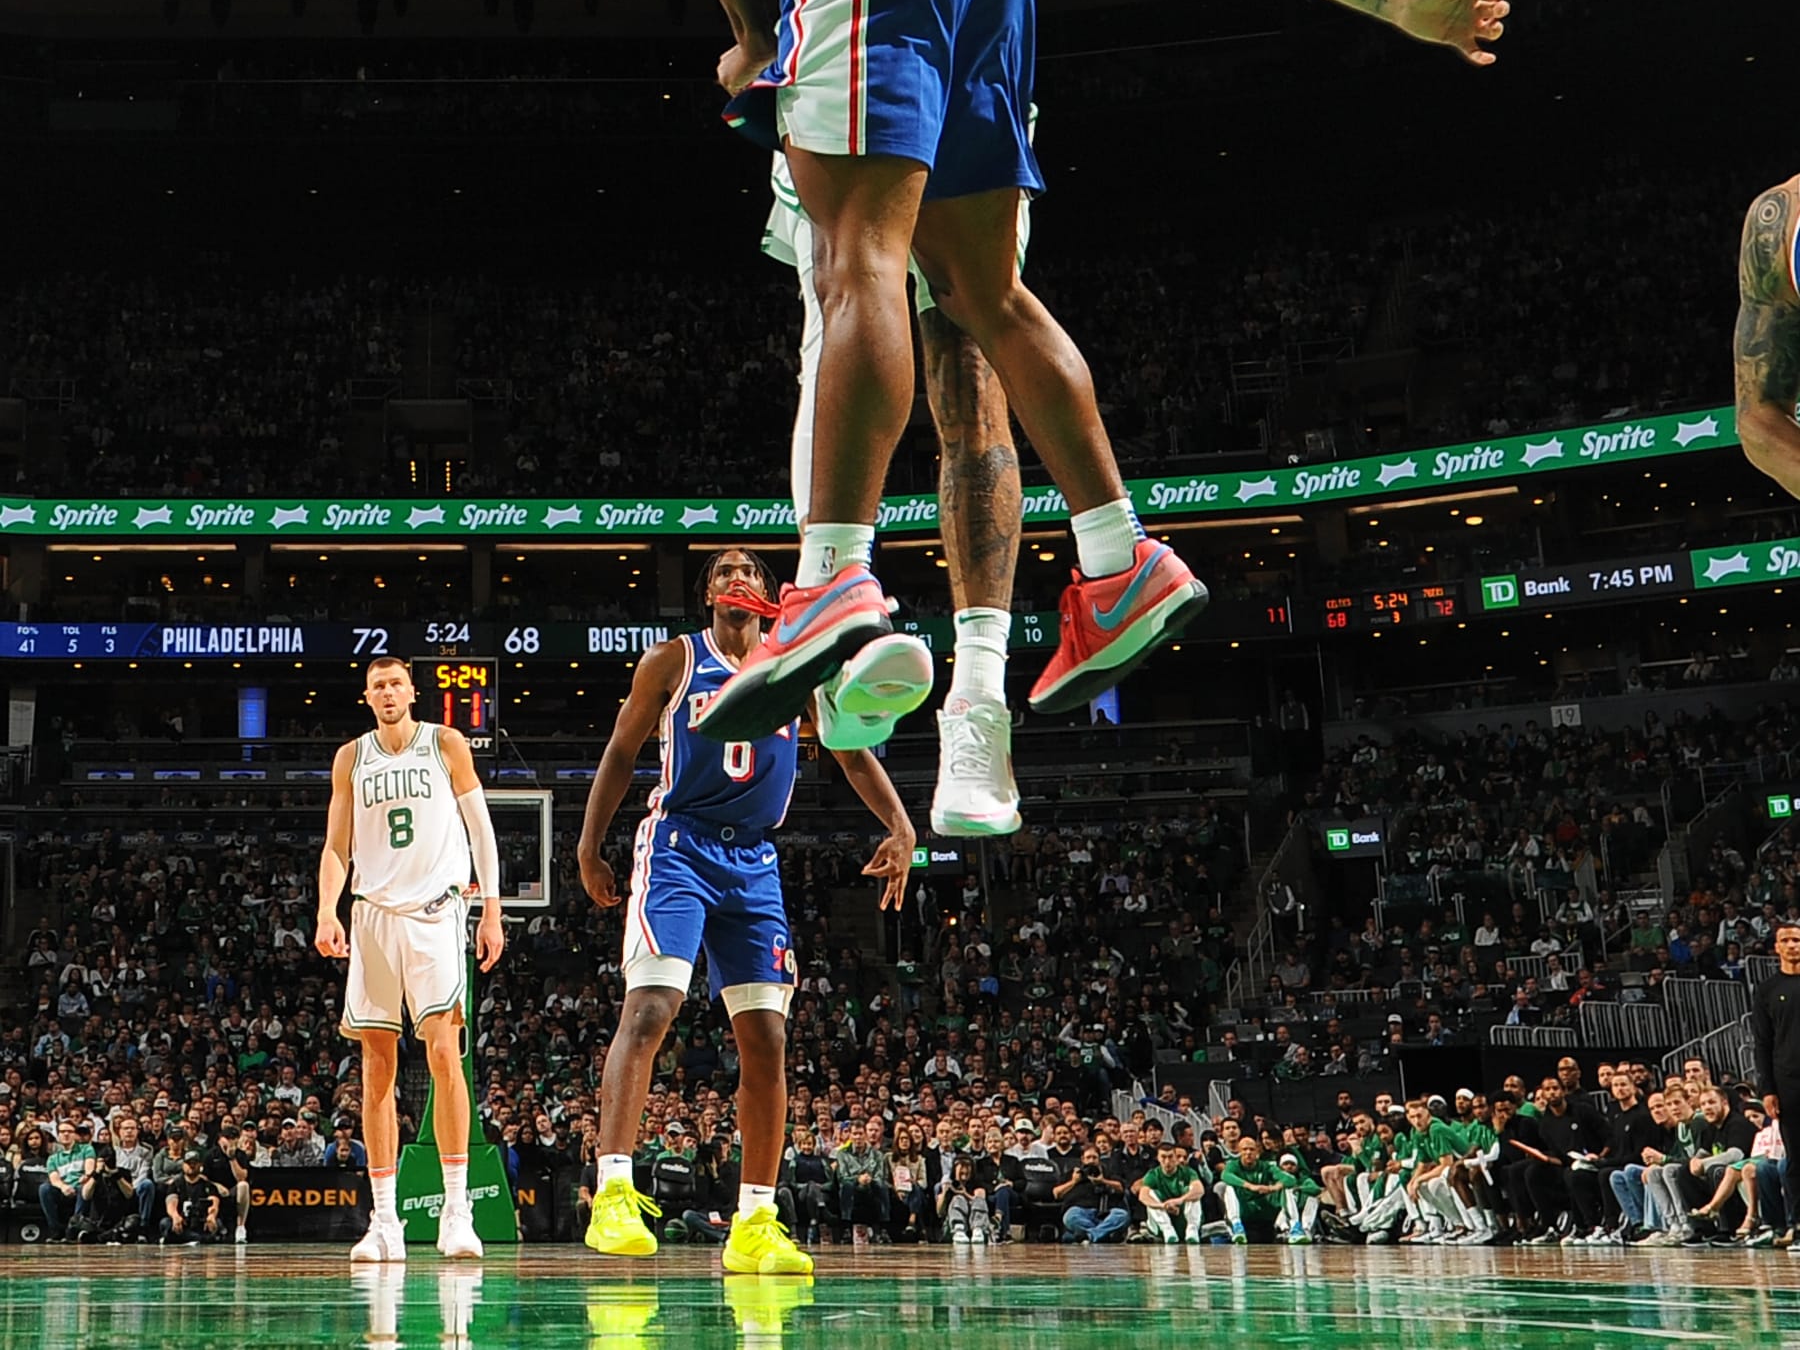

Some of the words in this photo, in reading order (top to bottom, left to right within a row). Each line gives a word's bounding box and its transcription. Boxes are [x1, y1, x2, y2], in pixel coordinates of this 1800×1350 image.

[1579, 425, 1655, 460] Sprite
[1432, 445, 1504, 479] Sprite
[1147, 479, 1219, 509] Sprite
[1292, 466, 1360, 499] Sprite
[49, 504, 118, 530] Sprite
[186, 504, 255, 530] Sprite
[322, 503, 392, 530] Sprite
[459, 503, 528, 530] Sprite
[595, 503, 664, 530] Sprite
[874, 499, 937, 528] Sprite
[1484, 581, 1515, 602] TD
[1524, 576, 1570, 596] Bank
[1589, 570, 1635, 590] 7:45
[1640, 564, 1673, 585] PM
[1373, 592, 1409, 610] 5:24
[1435, 601, 1454, 615] 72
[1024, 615, 1038, 624] TO
[1266, 607, 1286, 624] 11
[1327, 612, 1347, 628] 68
[1393, 611, 1400, 623] 3
[63, 626, 80, 635] TOL
[101, 626, 117, 635] FLS
[162, 627, 304, 653] PHILADELPHIA
[352, 628, 388, 655] 72
[425, 623, 470, 643] 5:24
[505, 627, 540, 654] 68
[588, 627, 668, 652] BOSTON
[1025, 628, 1042, 642] 10
[19, 639, 35, 652] 41
[68, 639, 77, 652] 5
[105, 639, 115, 652] 3
[439, 645, 457, 656] 3rd
[436, 665, 487, 688] 5:24
[1556, 707, 1575, 723] 19
[724, 741, 755, 782] 0
[362, 769, 432, 809] CELTICS
[1769, 799, 1789, 814] TD
[388, 807, 414, 849] 8
[1328, 833, 1347, 846] TD
[1352, 831, 1380, 844] Bank
[931, 850, 958, 861] Bank
[251, 1189, 357, 1207] GARDEN
[403, 1185, 500, 1211] EVERNE'S
